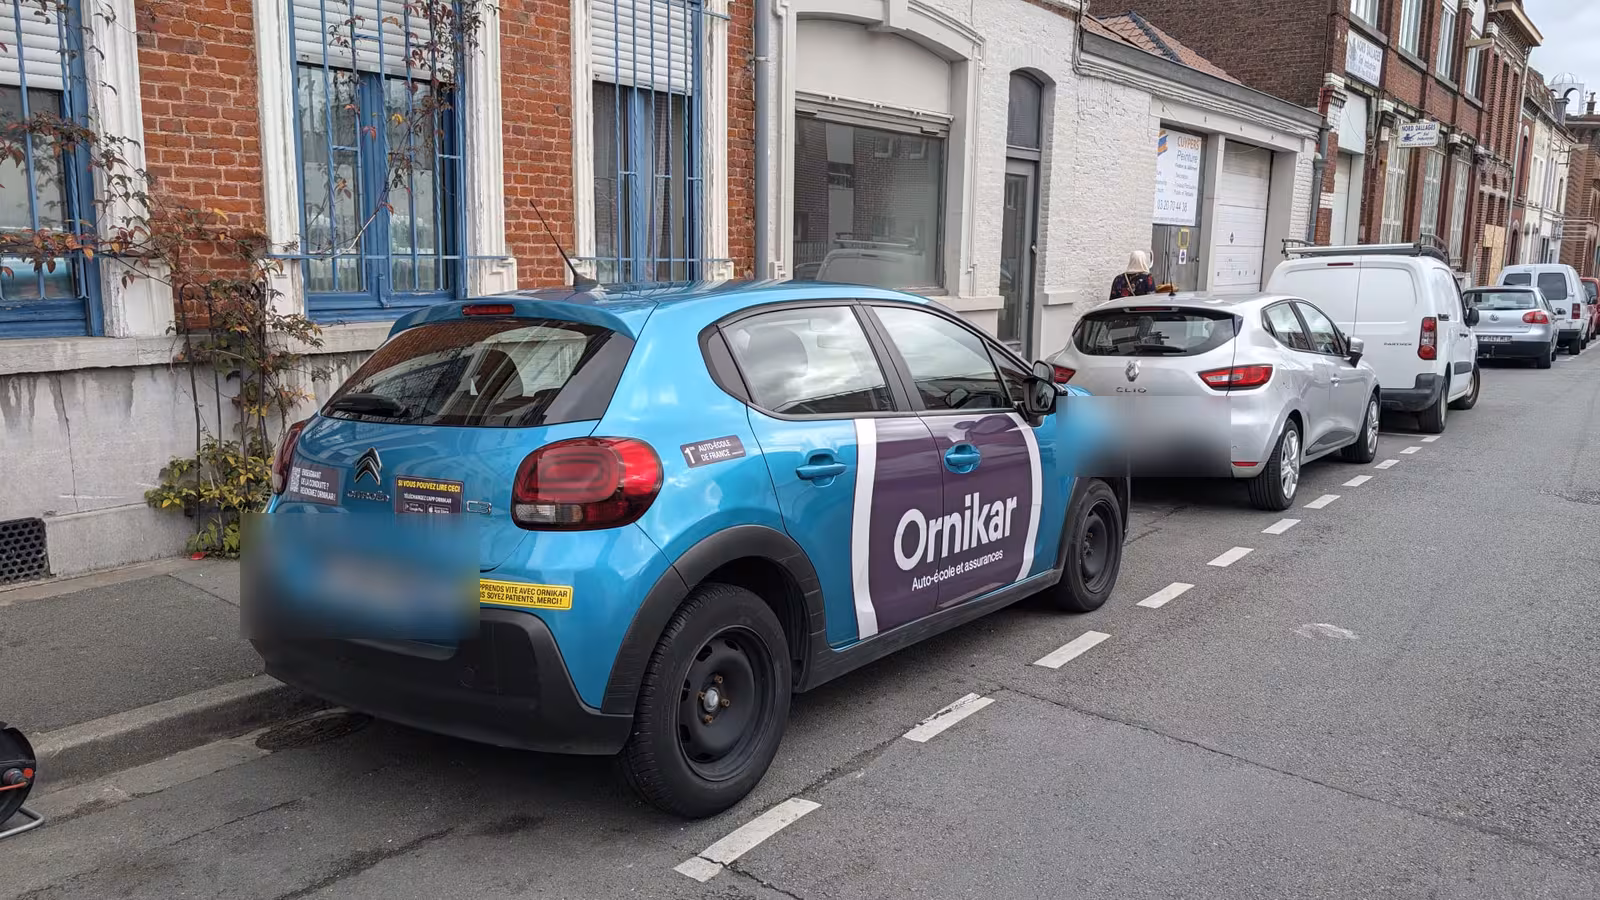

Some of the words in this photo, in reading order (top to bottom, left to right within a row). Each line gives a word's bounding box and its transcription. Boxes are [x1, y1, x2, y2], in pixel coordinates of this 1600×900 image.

[1177, 136, 1200, 150] CUYPERS
[1176, 150, 1199, 163] Peinture
[698, 440, 731, 453] AUTO-ÉCOLE
[701, 453, 710, 461] DE
[709, 449, 731, 460] FRANCE
[403, 480, 416, 488] VOUS
[416, 481, 436, 490] POUVEZ
[436, 483, 448, 491] LIRE
[466, 500, 492, 513] C3
[894, 492, 1017, 571] Ornikar
[912, 566, 955, 591] Auto-école
[956, 563, 964, 575] et
[964, 550, 1003, 572] assurances
[487, 592, 505, 601] SOYEZ
[505, 594, 536, 604] PATIENTS,
[537, 597, 559, 605] MERCI
[505, 586, 518, 594] VITE
[519, 587, 536, 596] AVEC
[536, 589, 568, 598] ORNIKAR
